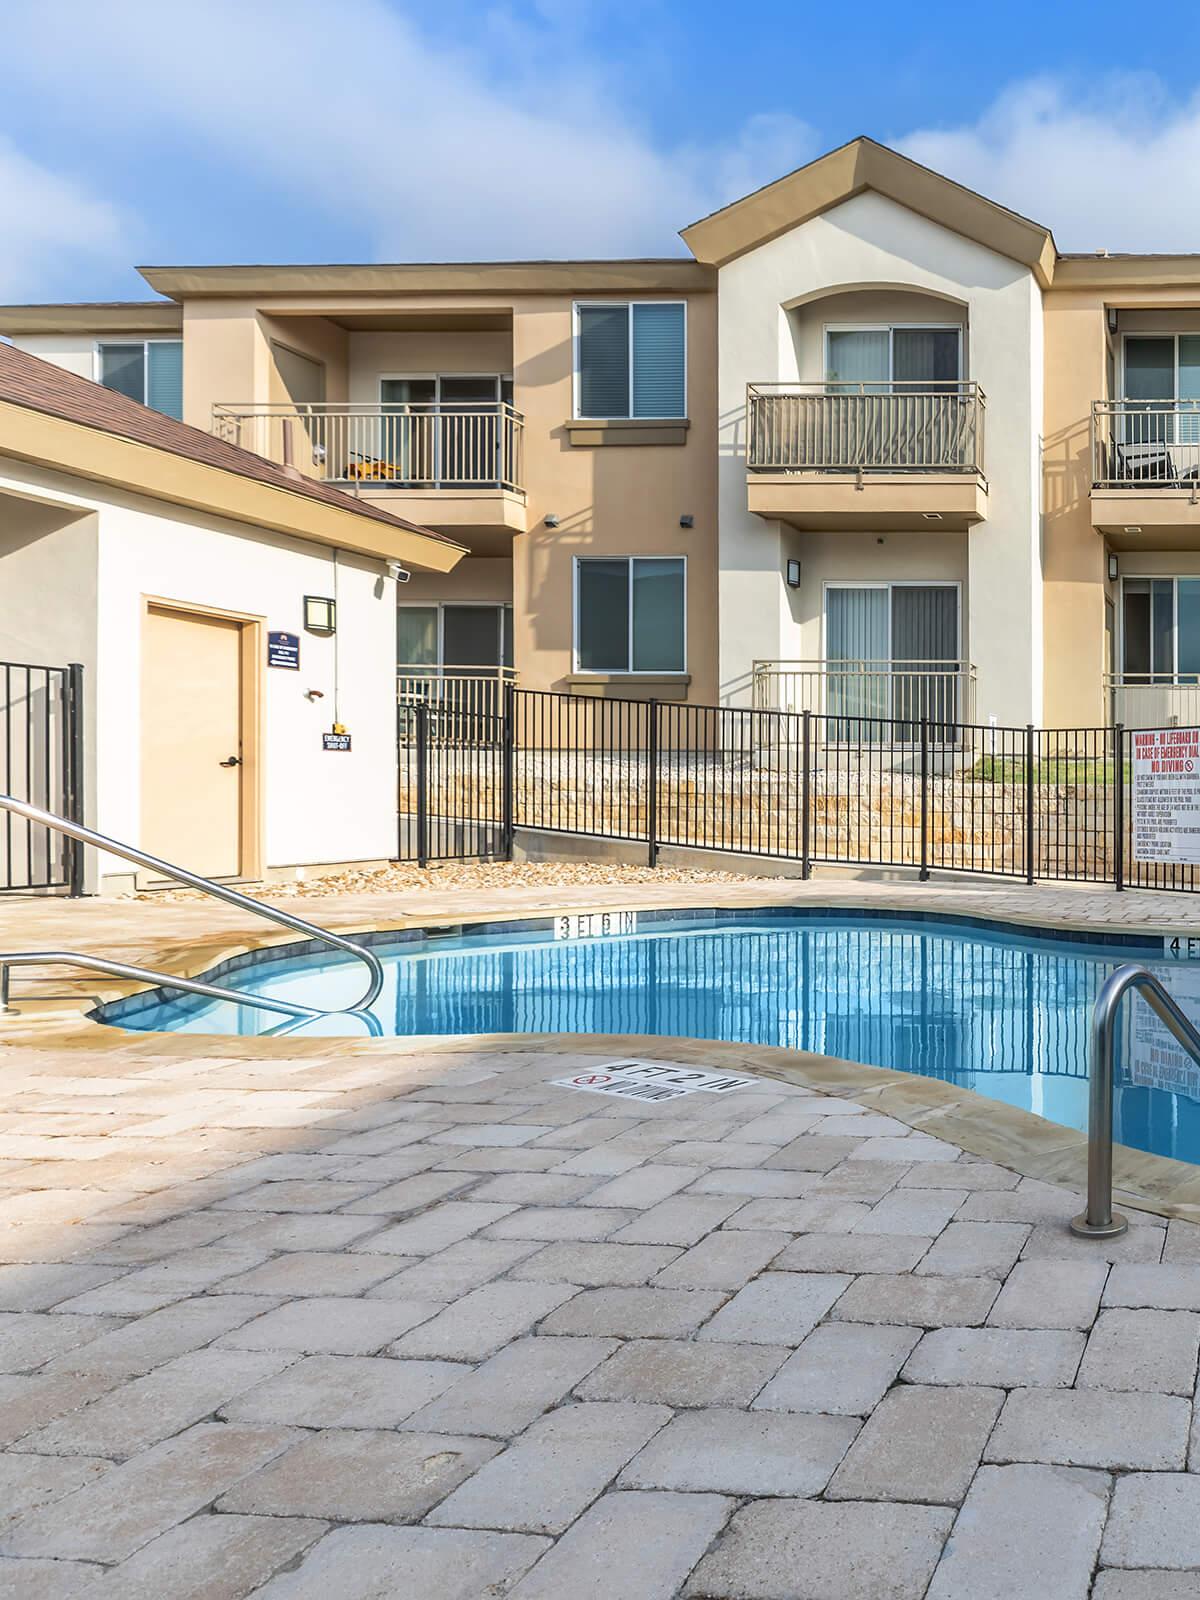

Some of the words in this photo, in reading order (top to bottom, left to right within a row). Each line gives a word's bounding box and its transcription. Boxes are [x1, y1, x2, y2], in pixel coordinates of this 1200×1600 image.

[1142, 747, 1152, 759] CASE
[1161, 745, 1188, 759] EMERGENCY
[1151, 760, 1160, 773] NO
[1161, 759, 1184, 773] DIVING
[1169, 937, 1180, 950] 4
[604, 1063, 640, 1073] 4
[625, 1066, 681, 1079] FT
[665, 1073, 706, 1083] 2
[698, 1077, 749, 1090] IN
